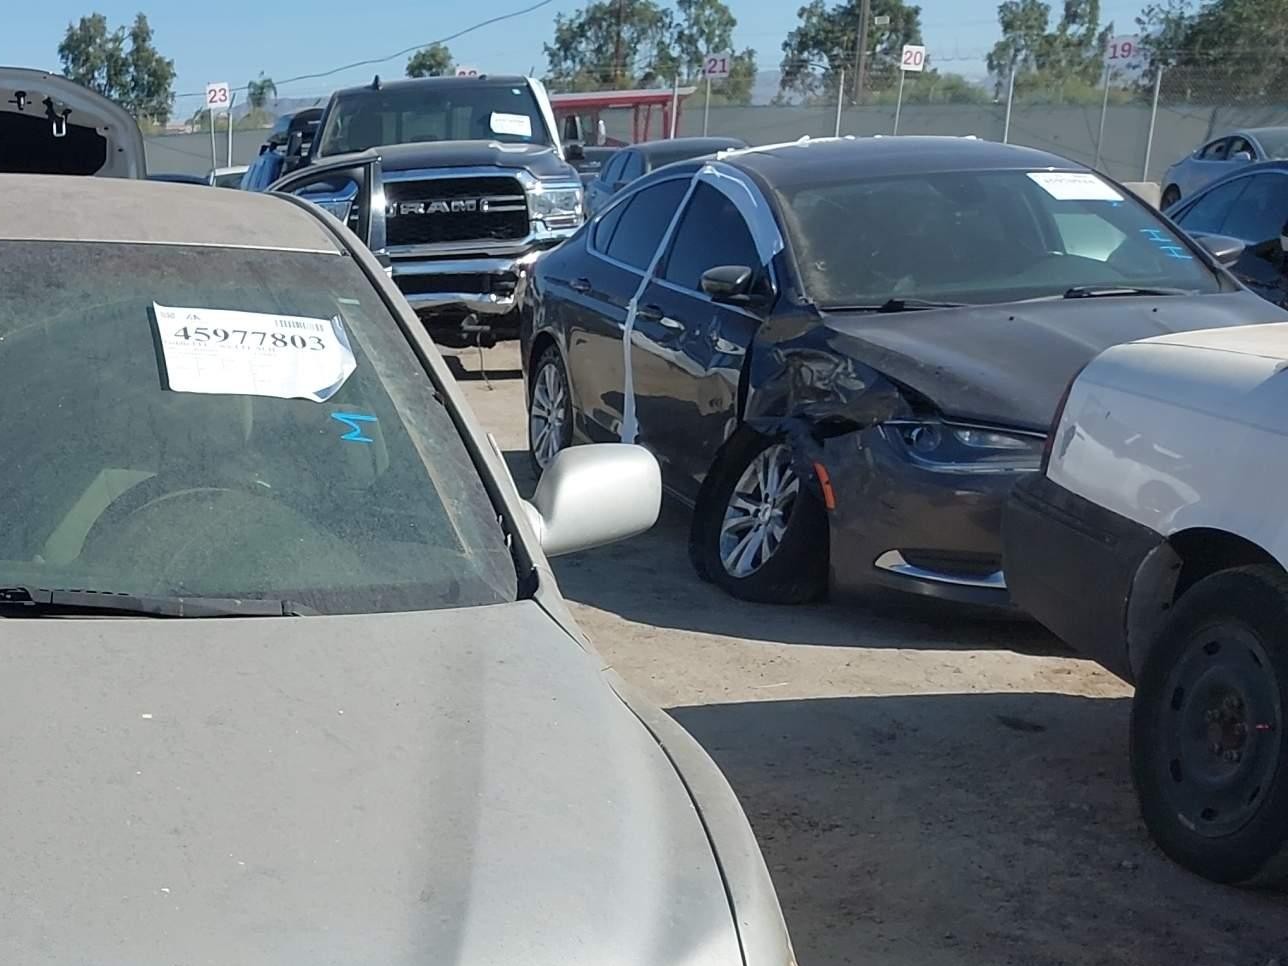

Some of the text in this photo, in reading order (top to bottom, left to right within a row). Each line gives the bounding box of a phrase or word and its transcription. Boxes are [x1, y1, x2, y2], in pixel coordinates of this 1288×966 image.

[903, 50, 922, 65] 20
[1109, 42, 1132, 59] 19
[708, 58, 728, 73] 21
[208, 88, 228, 104] 23
[399, 199, 477, 215] RAM
[173, 325, 326, 351] 45977803
